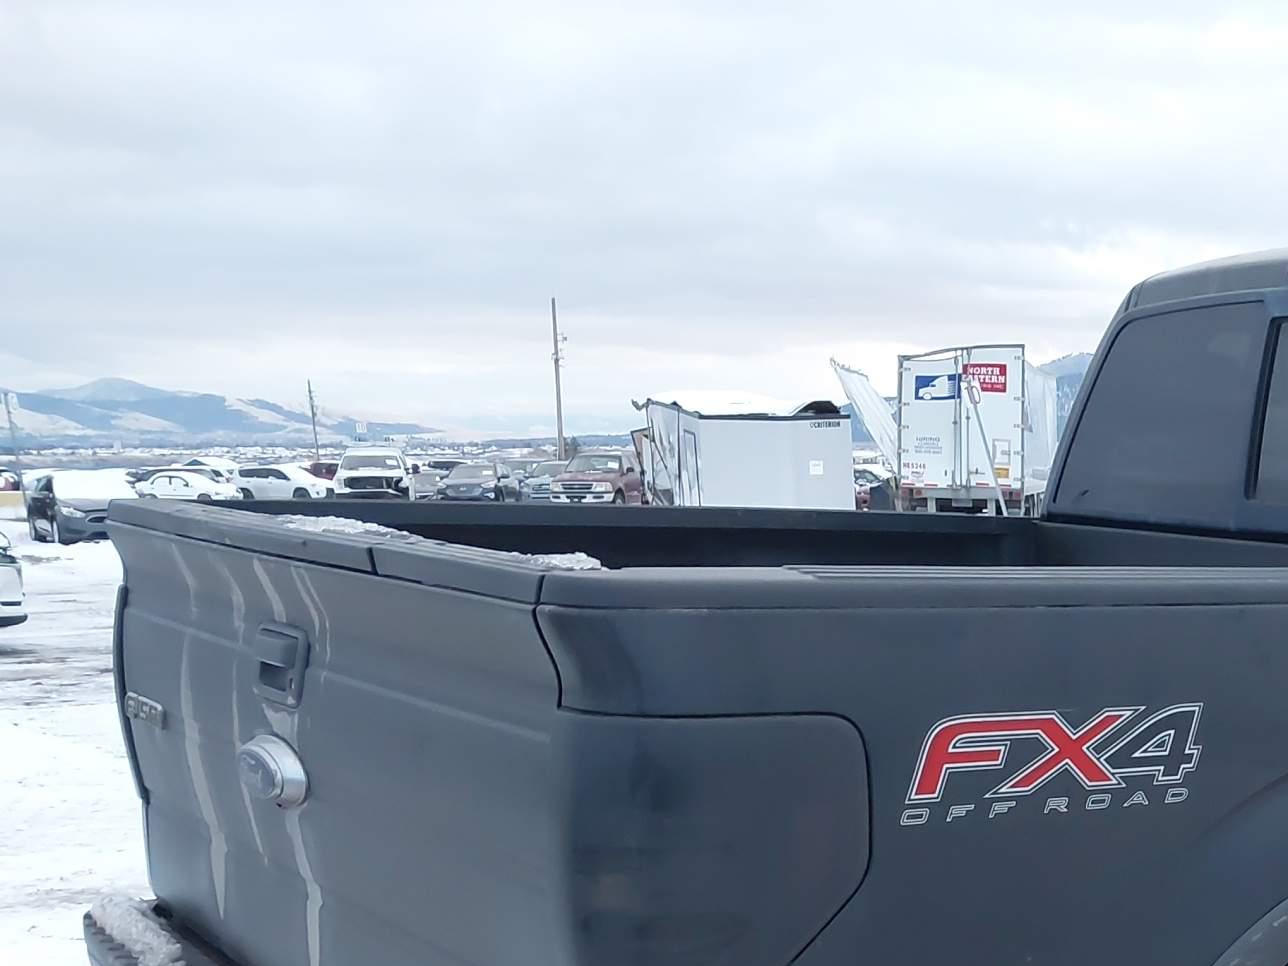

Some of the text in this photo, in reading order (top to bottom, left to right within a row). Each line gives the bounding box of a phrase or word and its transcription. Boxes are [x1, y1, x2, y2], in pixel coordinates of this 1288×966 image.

[967, 366, 1001, 375] NORTH
[904, 701, 1205, 805] FX4
[899, 787, 1190, 827] OFF ROAD
